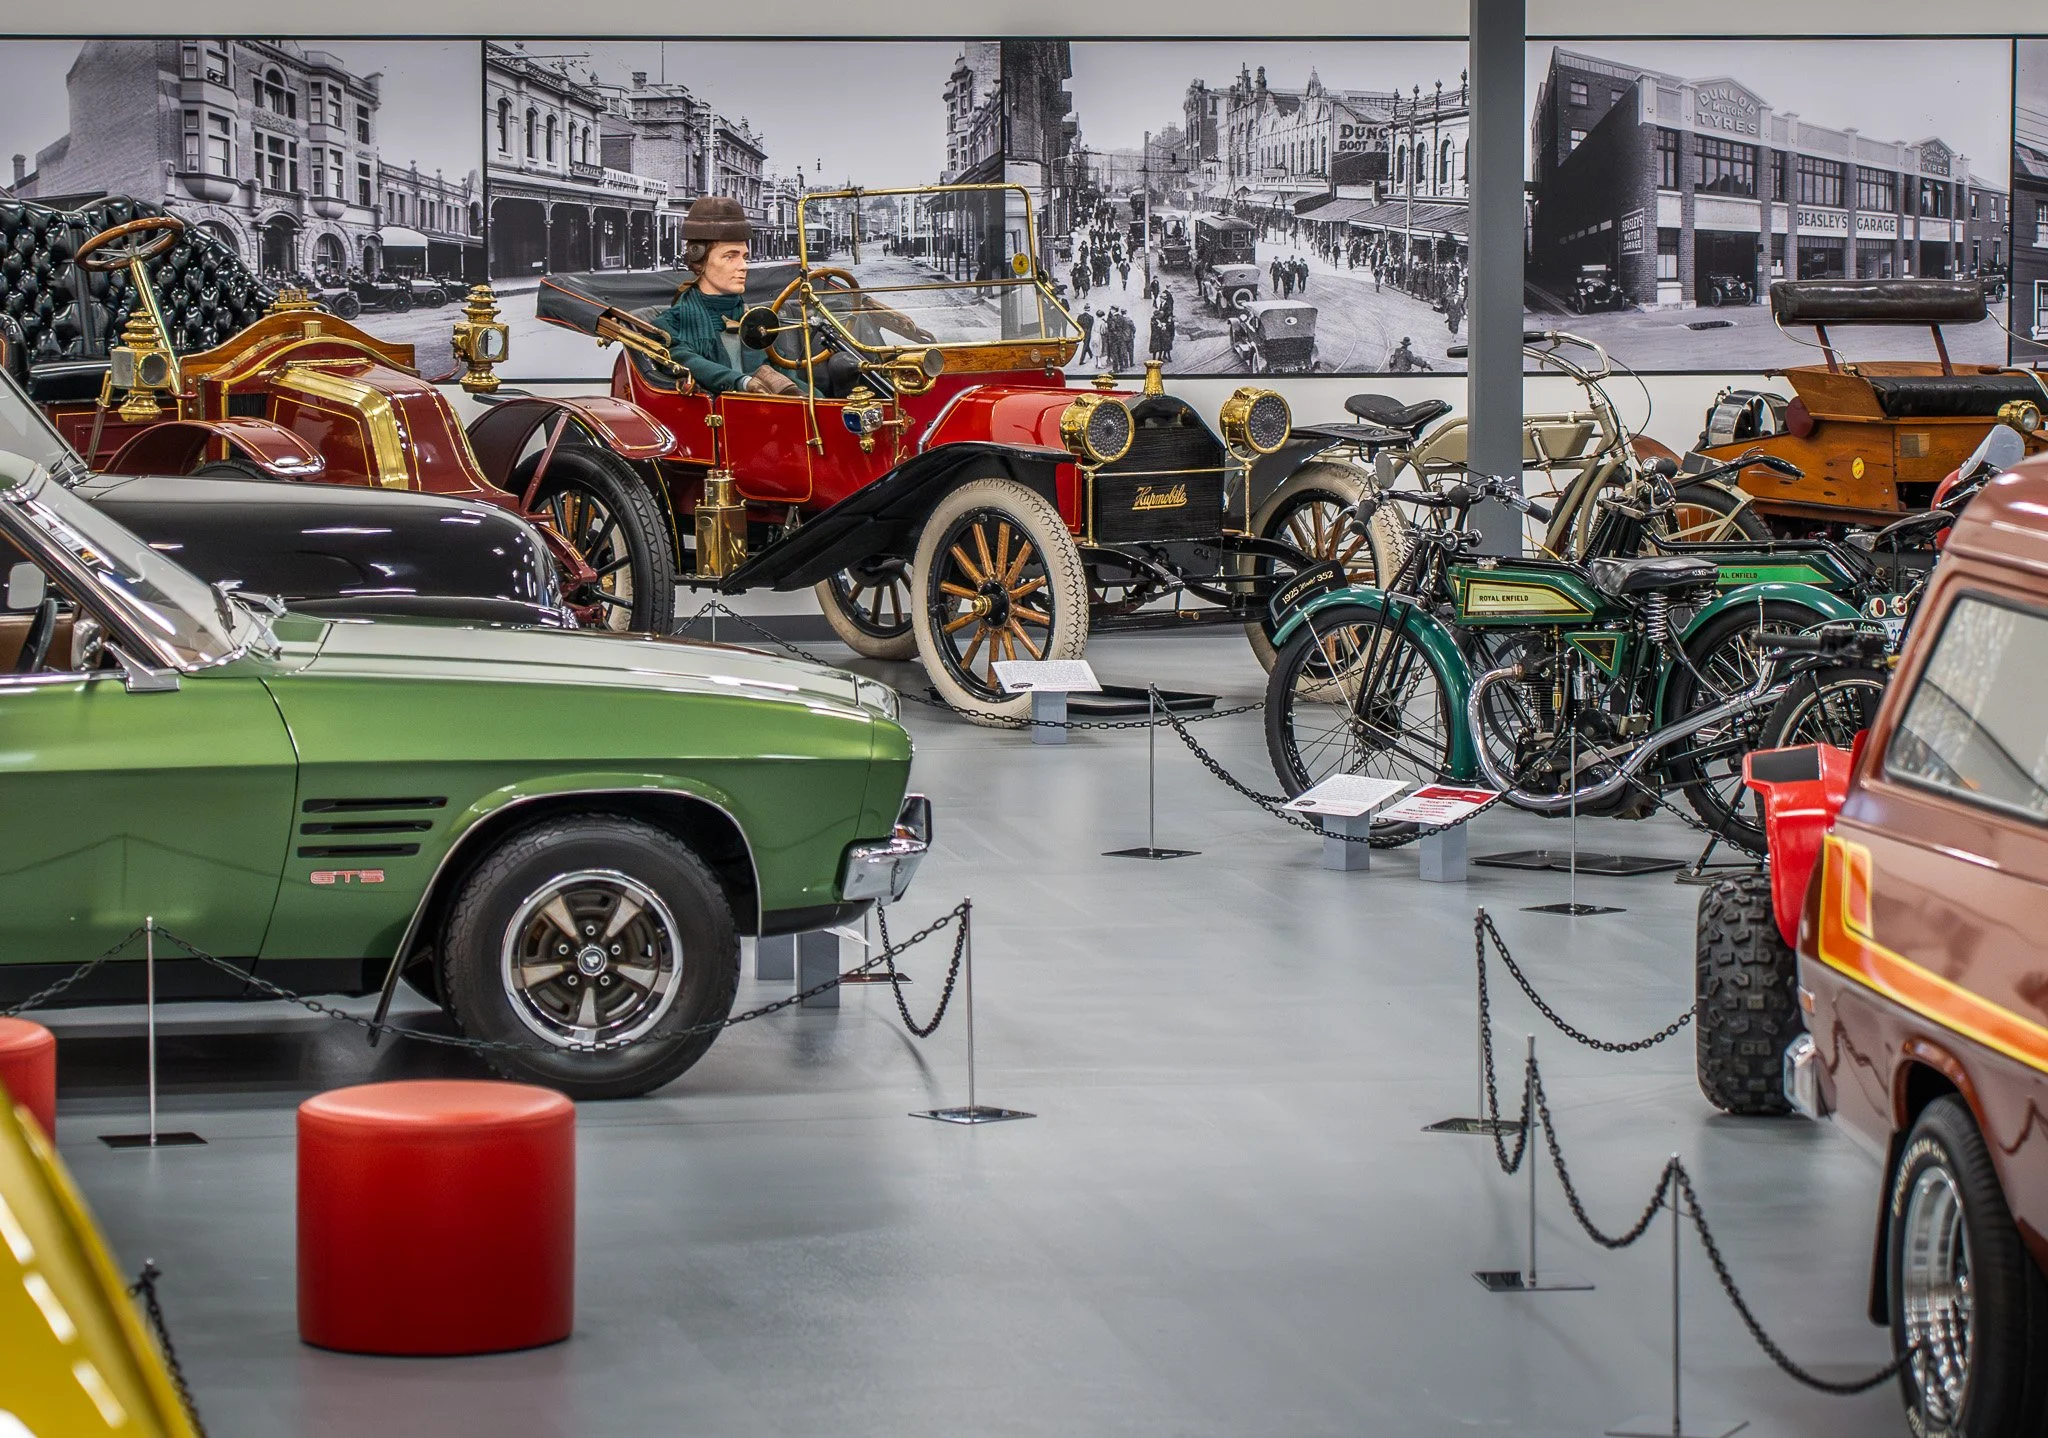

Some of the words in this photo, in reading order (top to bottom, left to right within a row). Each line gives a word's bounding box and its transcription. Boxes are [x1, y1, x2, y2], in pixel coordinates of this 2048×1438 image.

[1698, 87, 1757, 116] DUNLOP
[1711, 101, 1744, 118] MOTOR
[1697, 111, 1757, 135] TYRES
[1339, 140, 1368, 151] BOOT
[1921, 144, 1949, 161] DUNLOP
[1920, 162, 1948, 175] TYRES
[1797, 211, 1848, 229] BEASLEY'S
[1856, 217, 1896, 232] GARAGE
[1624, 229, 1640, 241] MOTOR
[1623, 239, 1641, 250] GARAGE
[1132, 484, 1188, 510] Hupmobile
[1282, 586, 1300, 604] 1925
[1316, 570, 1334, 582] 352
[310, 869, 385, 885] GTS
